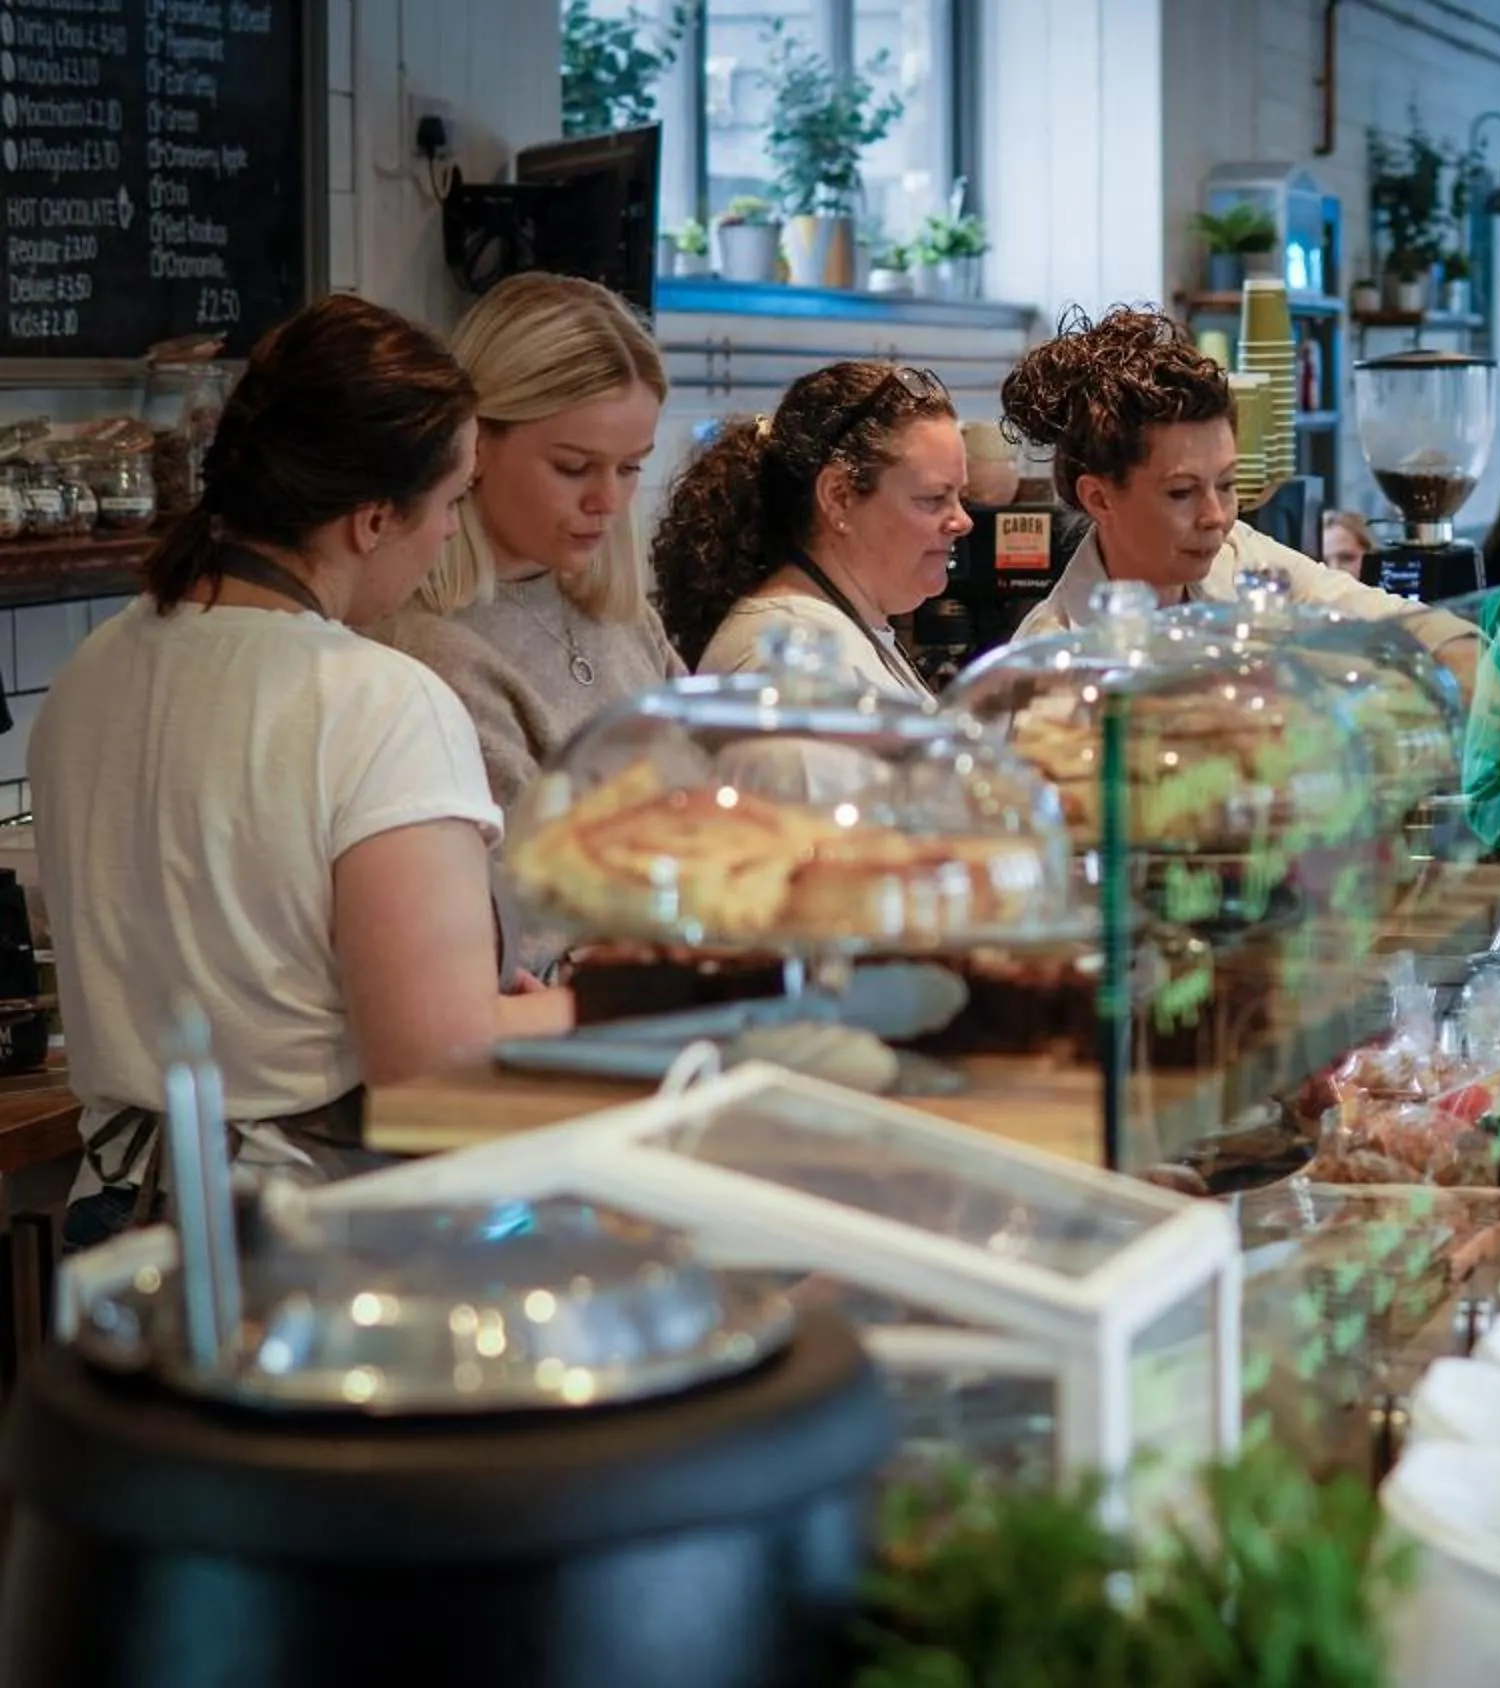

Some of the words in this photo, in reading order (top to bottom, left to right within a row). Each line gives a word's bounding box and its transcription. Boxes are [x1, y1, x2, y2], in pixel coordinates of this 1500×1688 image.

[6, 197, 38, 228] HOT
[40, 196, 118, 228] CHOCOLATE
[1002, 515, 1043, 536] CABER
